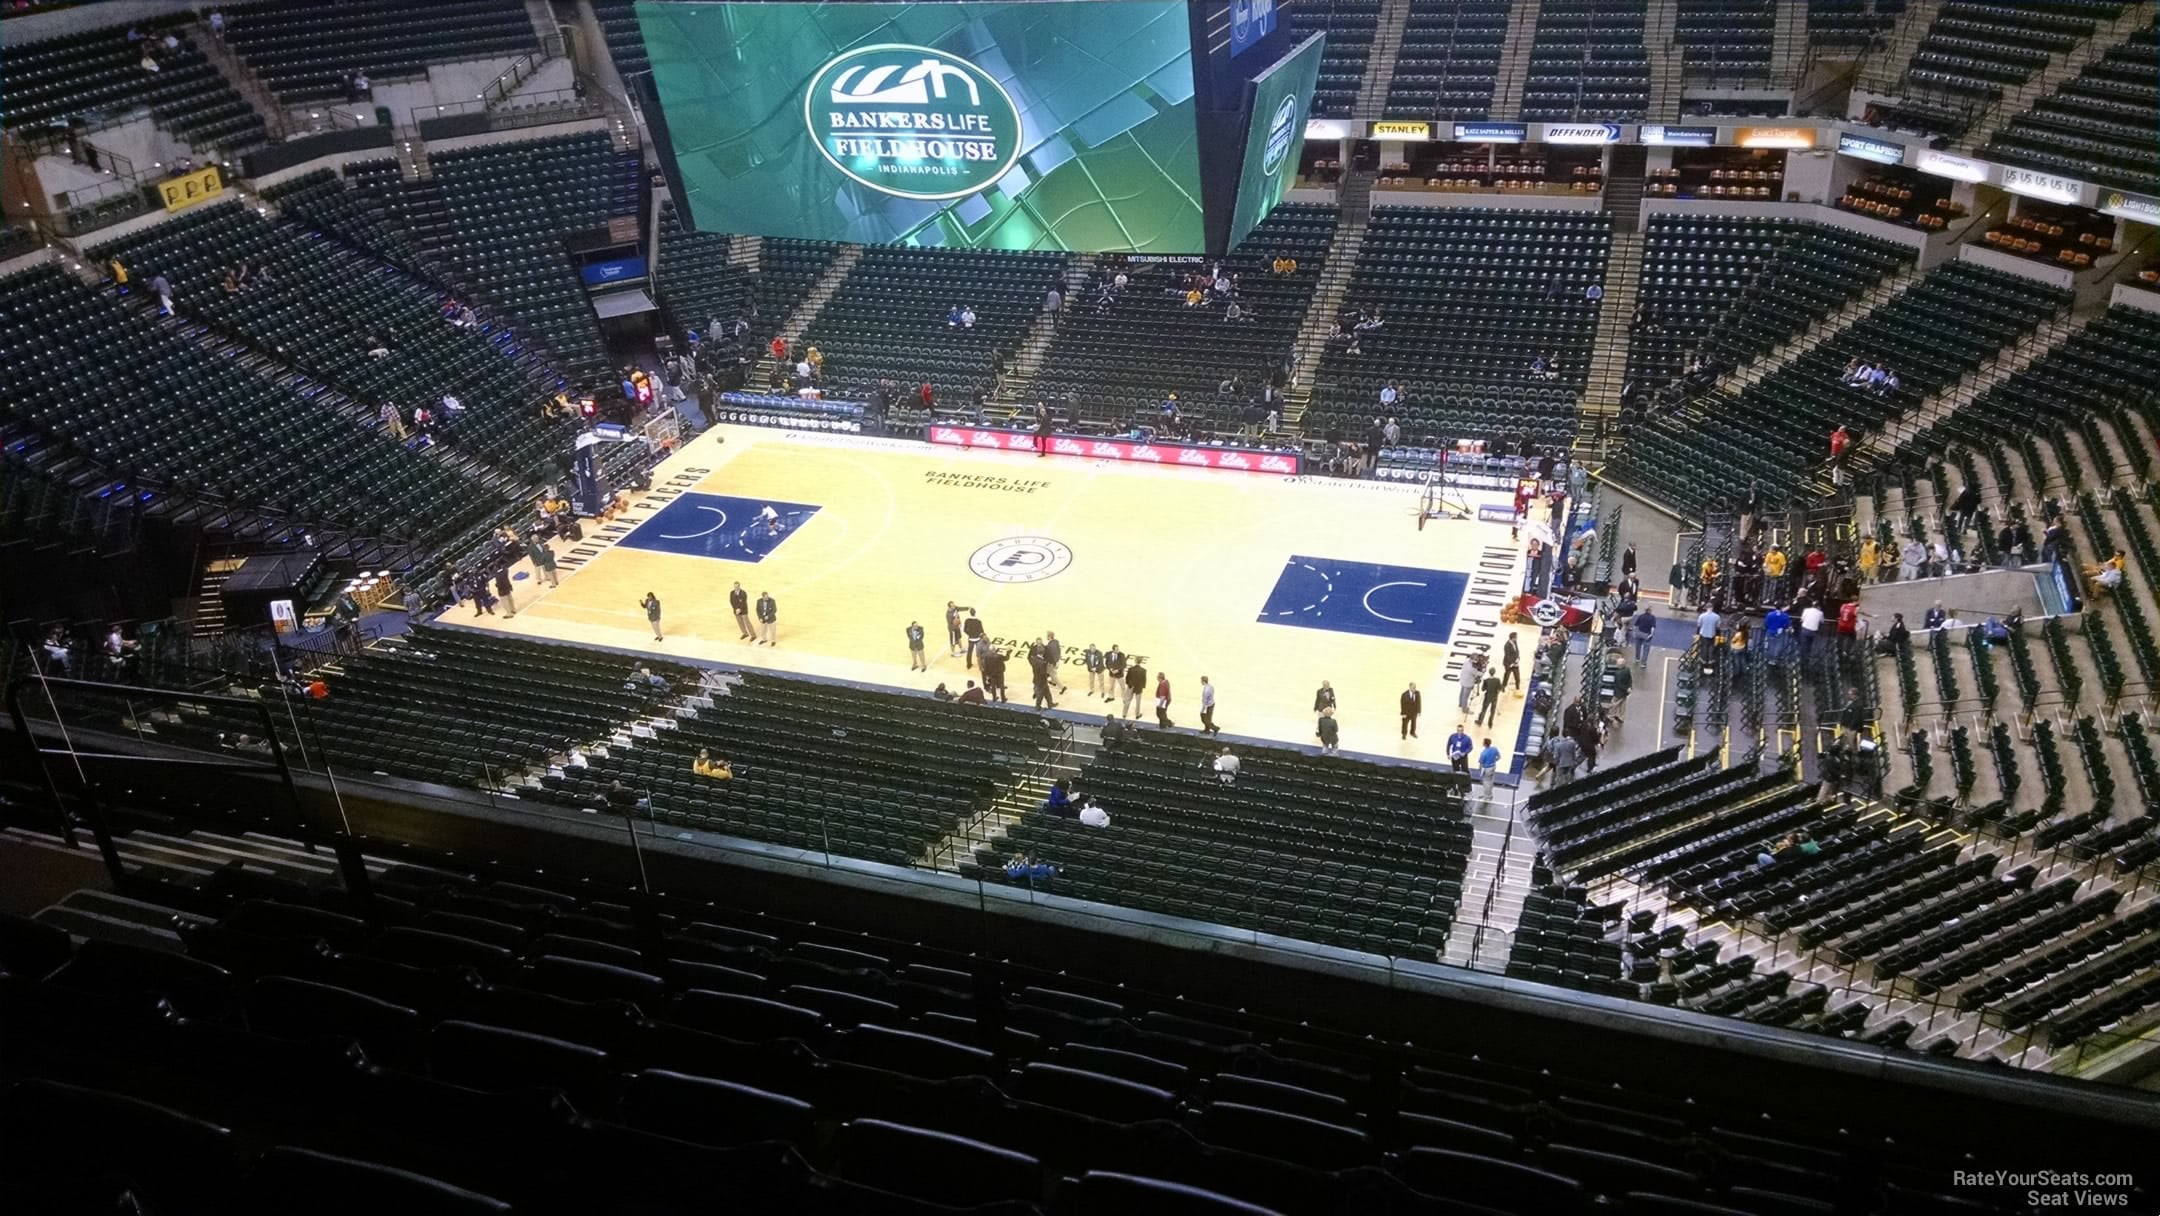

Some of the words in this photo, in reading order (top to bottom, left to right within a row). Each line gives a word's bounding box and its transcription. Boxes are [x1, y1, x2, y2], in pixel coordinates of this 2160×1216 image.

[829, 112, 945, 129] BANKERS
[948, 114, 992, 131] LIFE
[1550, 128, 1604, 137] DEFENDER
[835, 139, 997, 160] FIELDHOUSE
[1841, 138, 1865, 150] SPORT
[1866, 142, 1903, 158] GRAPHICS
[879, 165, 958, 175] INDIANAPOLIS
[935, 428, 964, 445] Lilly
[971, 431, 1000, 448] Lilly
[1054, 439, 1085, 455] Lilly
[1092, 442, 1122, 458] Lilly
[1131, 445, 1162, 462] Lilly
[1179, 449, 1209, 465] Lilly
[1219, 452, 1250, 469] Lilly
[1260, 455, 1292, 472] Lilly
[925, 471, 1007, 483] BANKERS
[1014, 479, 1051, 488] LIFE
[926, 477, 1037, 493] FIELDHOUSE
[556, 518, 644, 571] INDIANA
[634, 468, 711, 509] PACERS
[1466, 546, 1518, 606] INDIANA
[991, 637, 1087, 657] BANRS
